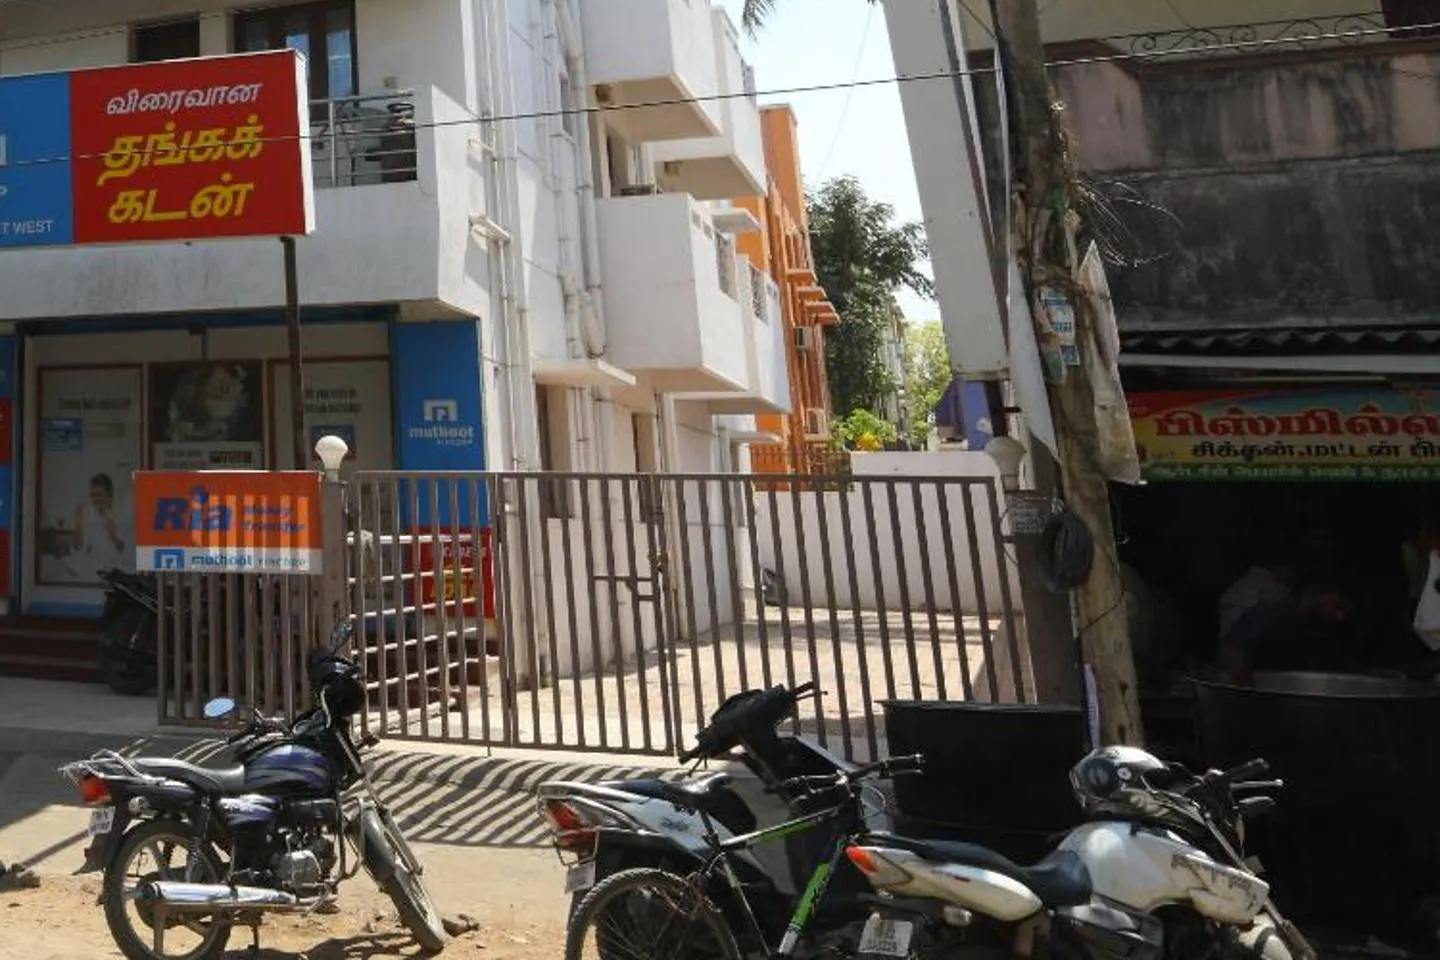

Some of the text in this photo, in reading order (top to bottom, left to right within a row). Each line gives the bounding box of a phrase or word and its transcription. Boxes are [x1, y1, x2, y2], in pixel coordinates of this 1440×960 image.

[106, 82, 264, 115] விரைவான
[96, 114, 265, 187] தங்கக்
[107, 172, 255, 224] கடன்
[12, 220, 54, 234] WEST
[153, 484, 233, 531] Ria
[191, 553, 253, 566] muthoot
